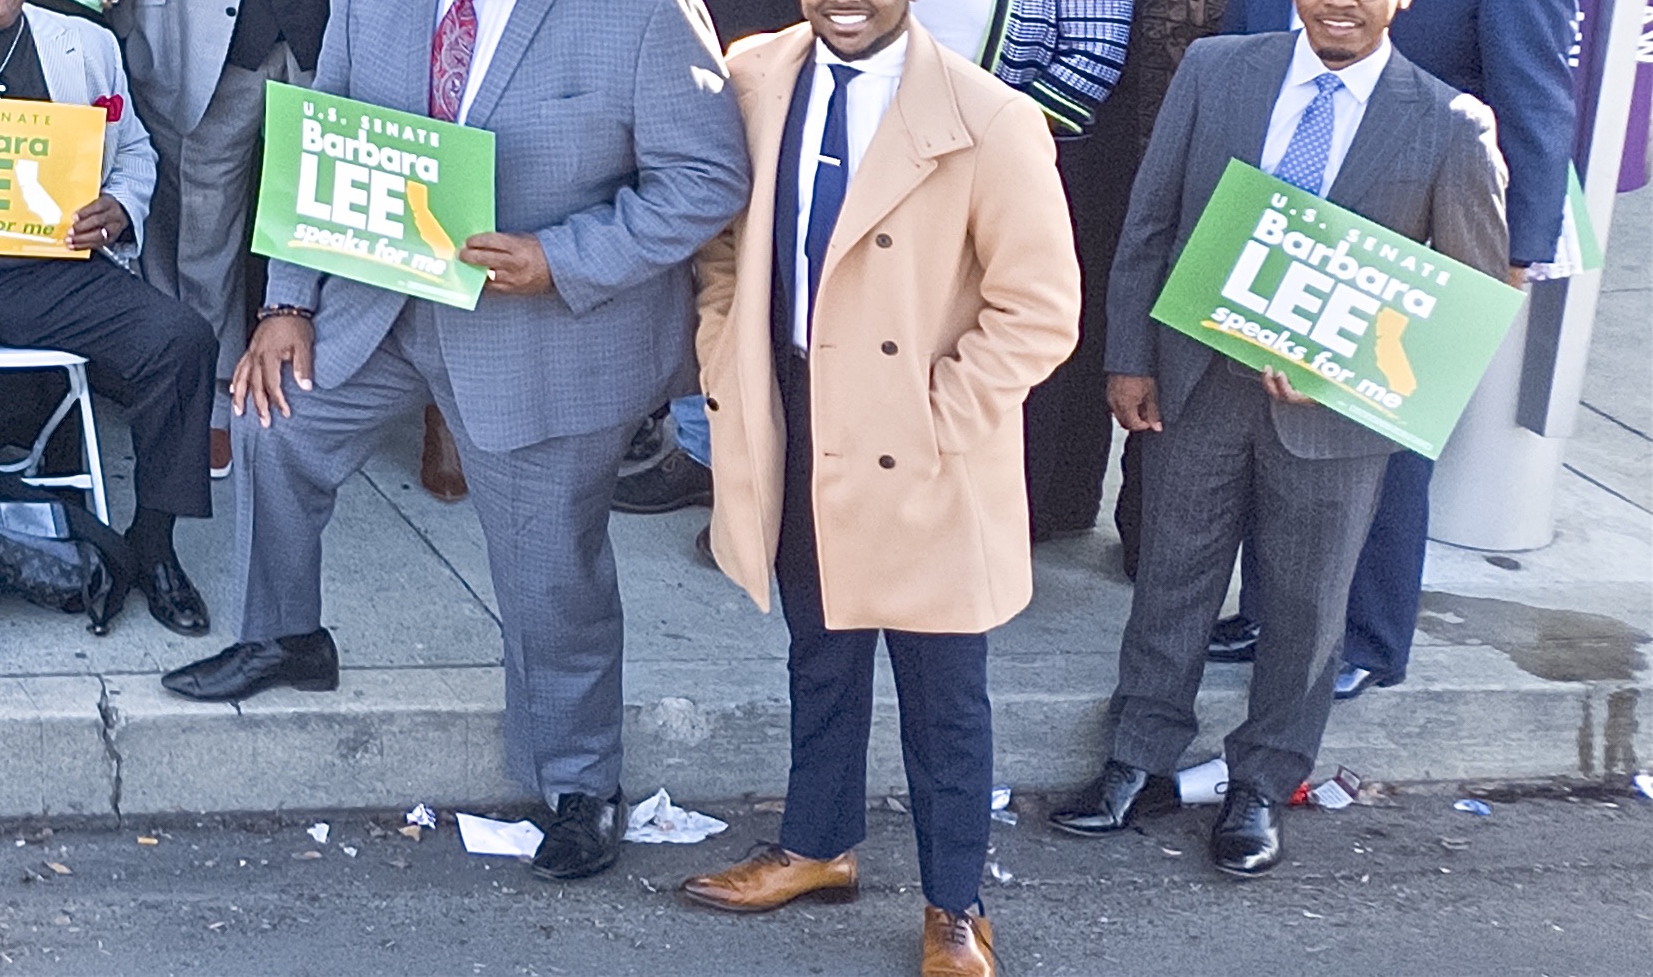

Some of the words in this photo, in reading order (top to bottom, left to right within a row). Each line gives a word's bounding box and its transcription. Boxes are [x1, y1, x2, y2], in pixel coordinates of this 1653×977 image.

[302, 118, 438, 183] Barbara
[303, 101, 346, 125] U.S.
[361, 116, 439, 147] SENATE
[23, 223, 54, 235] me
[296, 152, 405, 239] LEE
[295, 224, 369, 255] speaks
[375, 238, 407, 263] for
[411, 253, 446, 274] me
[1253, 208, 1437, 319] Barbara
[1271, 193, 1326, 229] U.S.
[1345, 229, 1451, 286] SENATE
[1222, 240, 1381, 359] LEE
[1211, 307, 1307, 361] speaks
[1310, 352, 1355, 383] for
[1357, 377, 1403, 408] me
